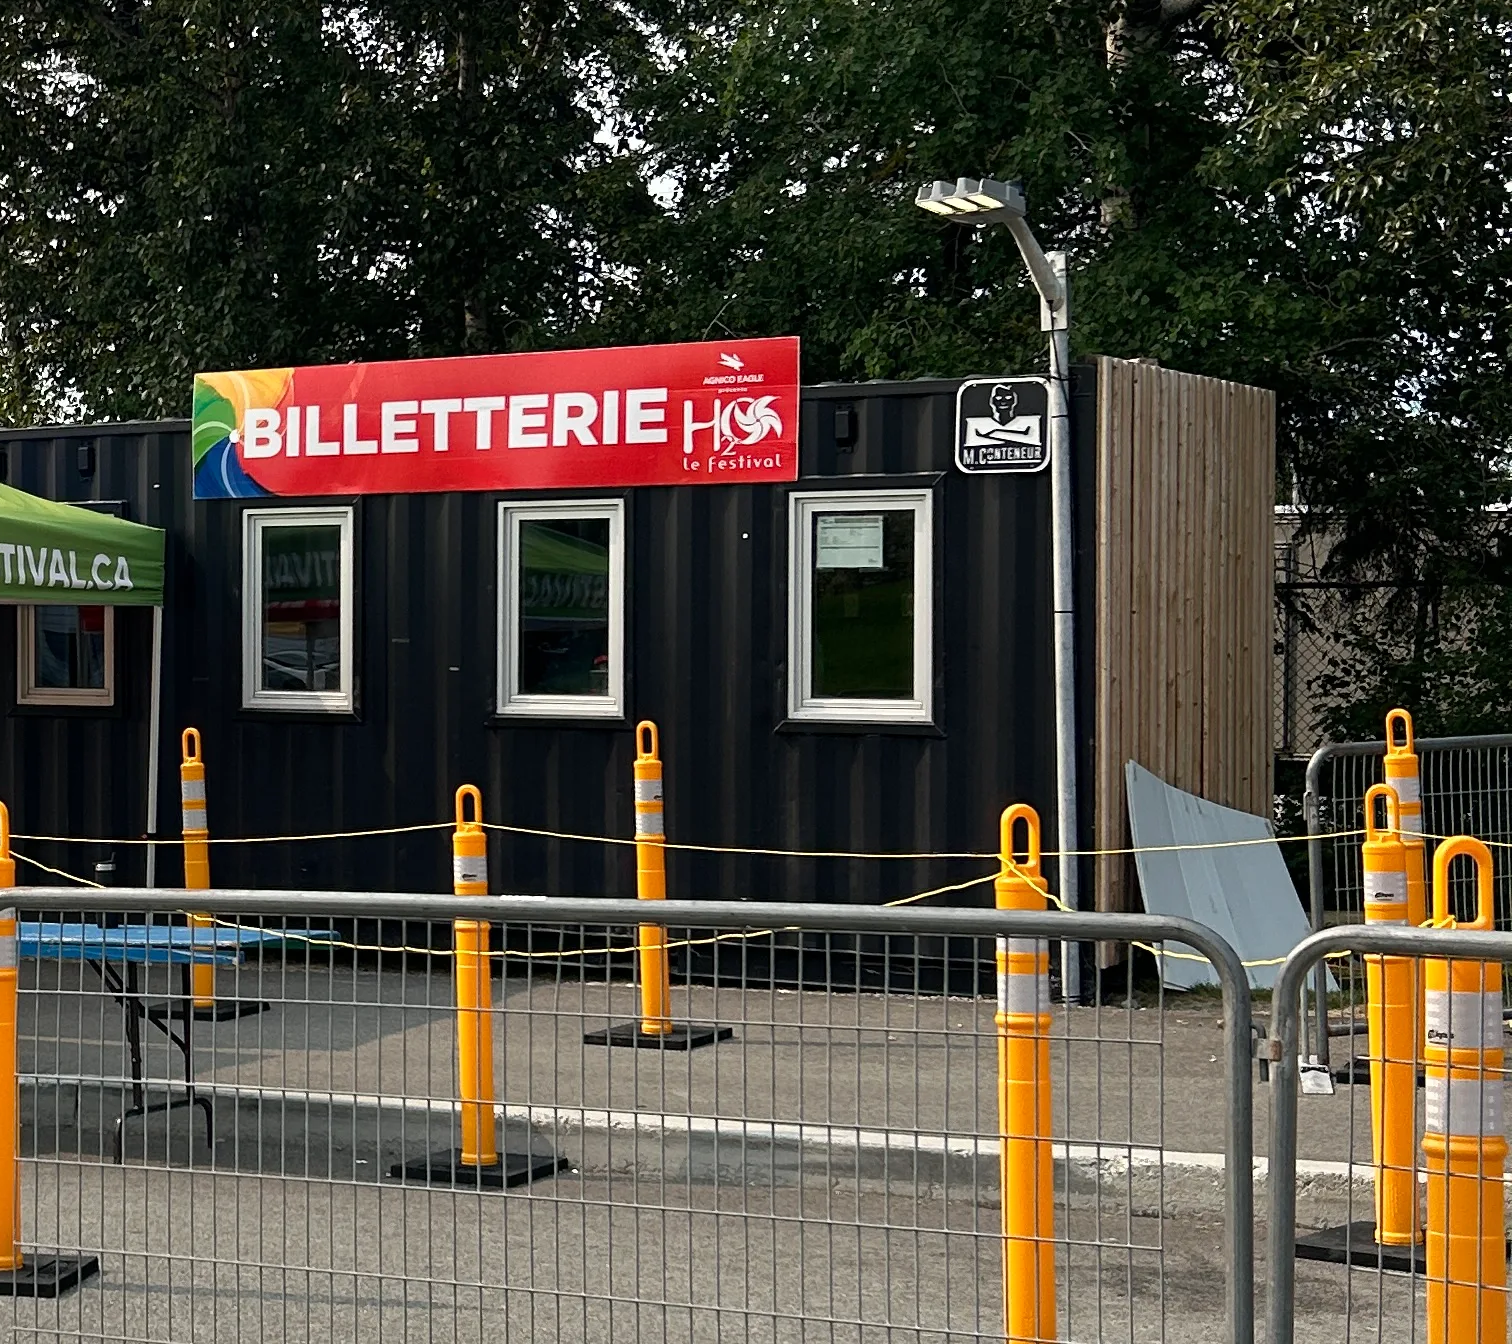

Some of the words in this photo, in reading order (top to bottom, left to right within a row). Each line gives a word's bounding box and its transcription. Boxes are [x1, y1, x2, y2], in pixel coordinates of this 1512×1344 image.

[737, 374, 764, 383] EAGLE
[243, 387, 668, 459] BILLETTERIE
[683, 456, 701, 471] le
[708, 453, 782, 473] festival
